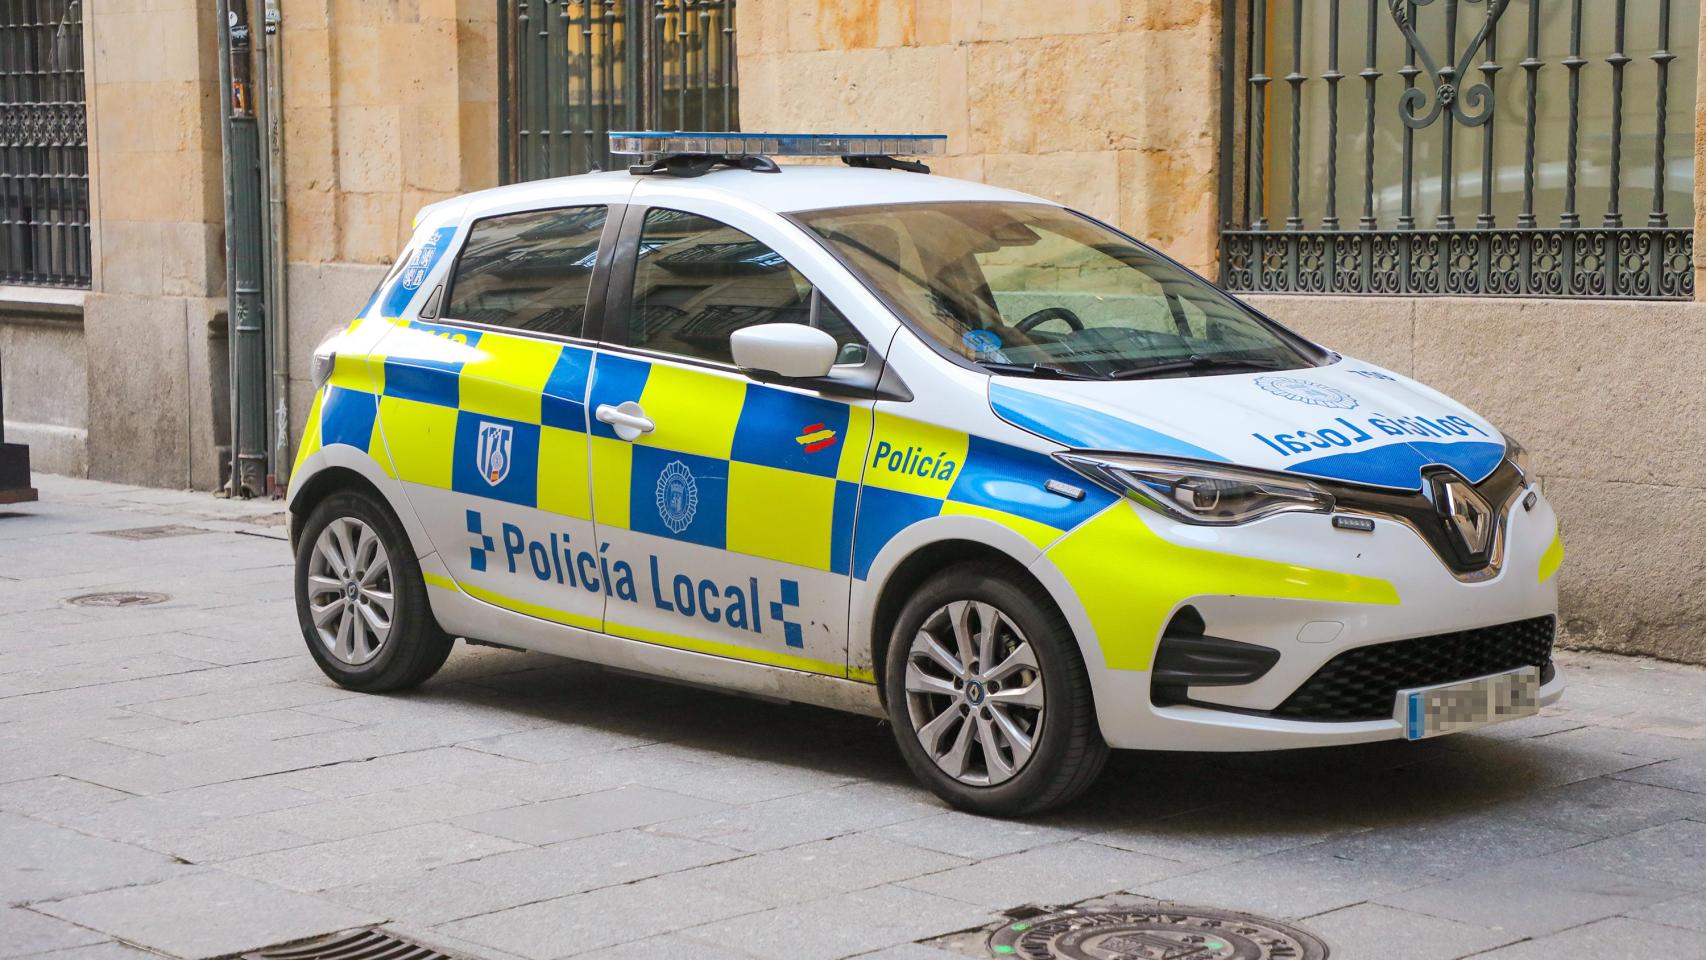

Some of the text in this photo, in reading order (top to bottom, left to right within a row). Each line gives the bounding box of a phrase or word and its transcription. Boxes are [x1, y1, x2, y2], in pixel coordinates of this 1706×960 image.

[872, 441, 956, 481] Policía
[502, 522, 762, 634] Policía Local
